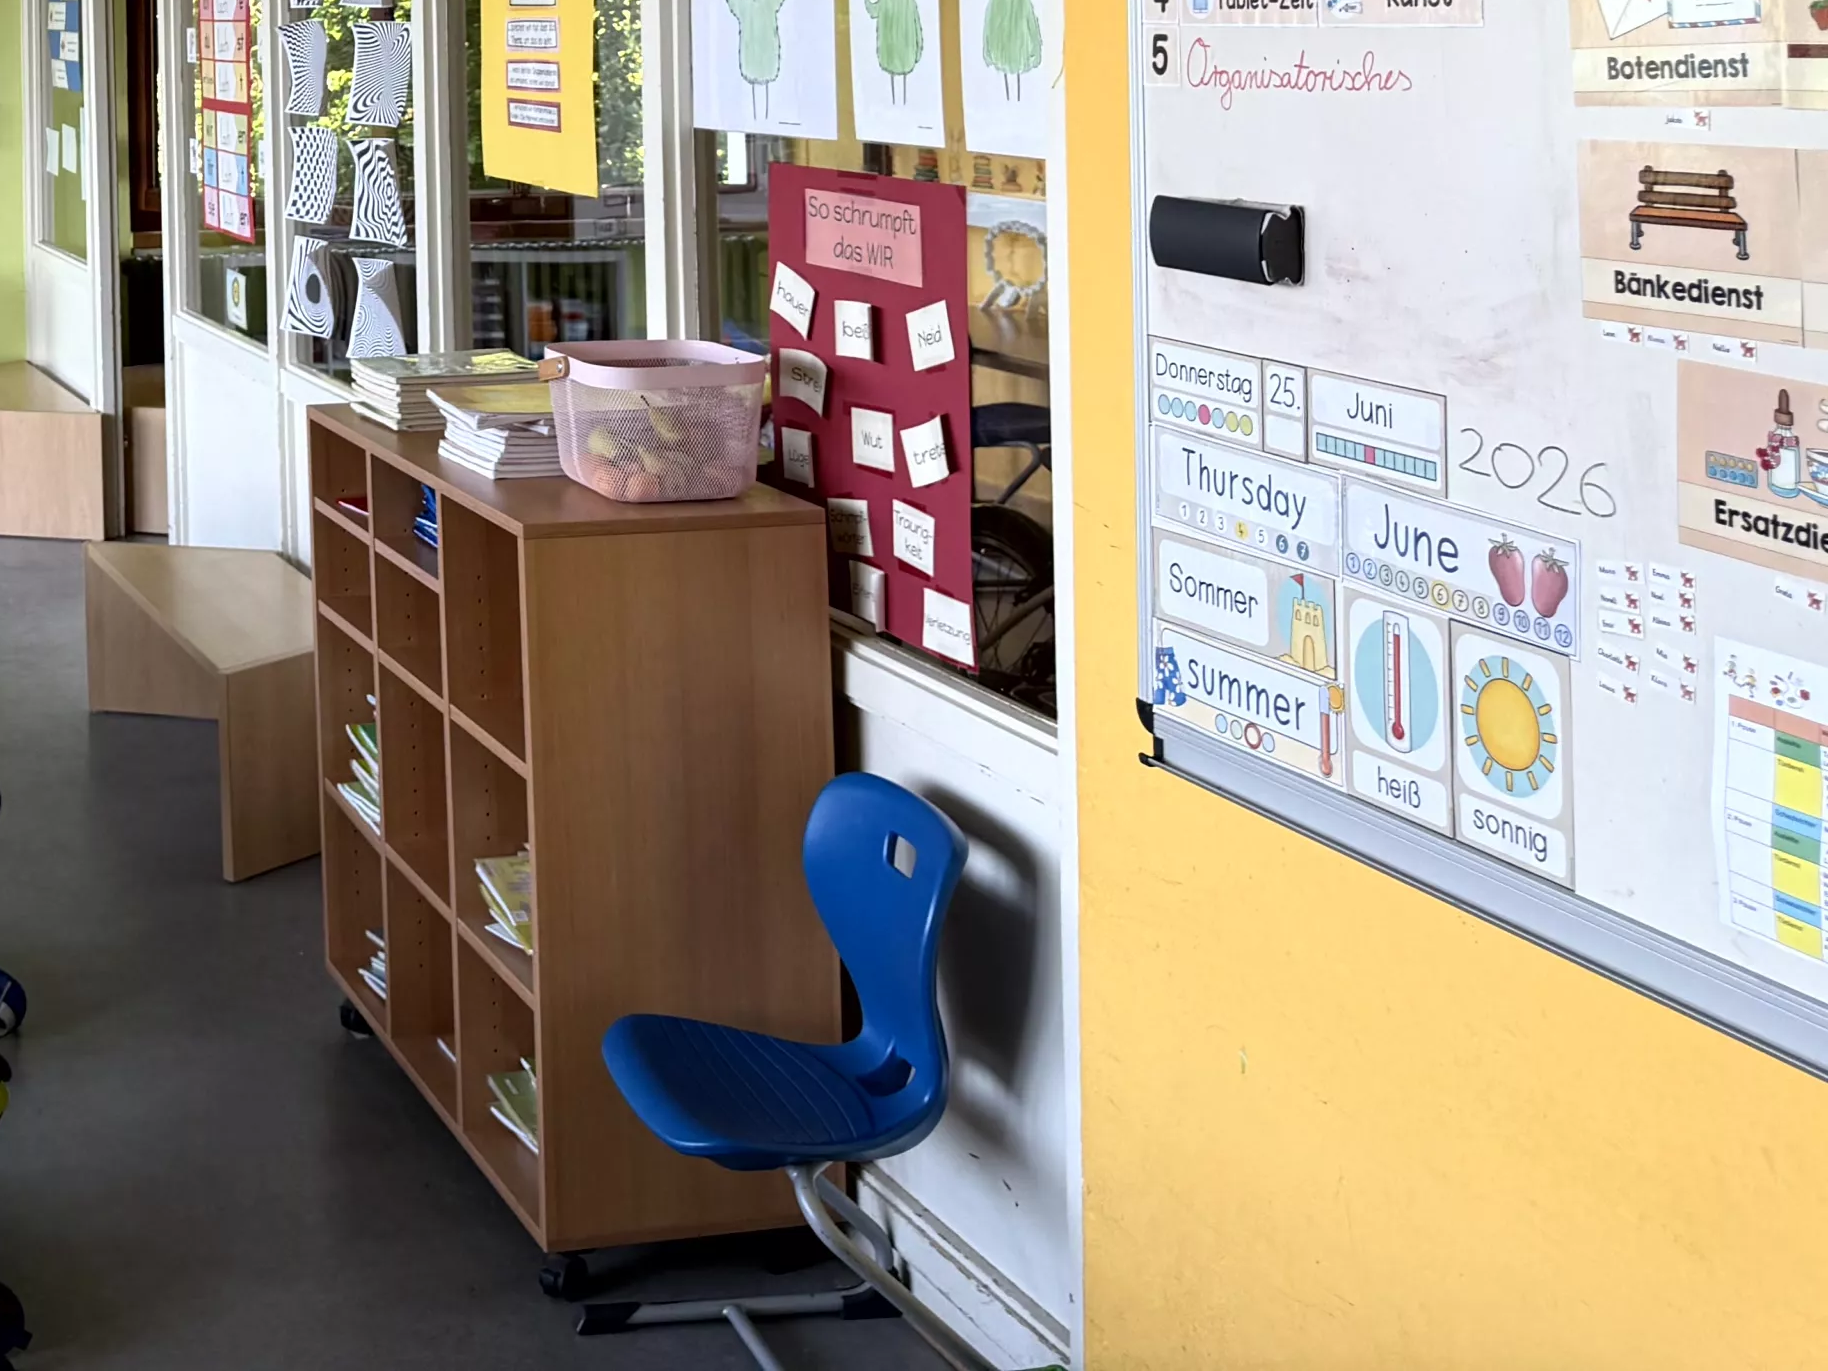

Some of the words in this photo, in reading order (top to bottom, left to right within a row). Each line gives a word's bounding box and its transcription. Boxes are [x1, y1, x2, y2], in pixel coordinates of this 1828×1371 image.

[1151, 34, 1168, 75] 5
[1187, 38, 1413, 110] Organisatorisches
[1607, 53, 1749, 80] Botendienst
[808, 196, 829, 219] So
[834, 201, 916, 238] schrumpft
[834, 237, 862, 262] das
[867, 245, 893, 269] WIR
[1614, 270, 1764, 310] Bänkedienst
[918, 327, 942, 348] Neid
[1156, 353, 1252, 404] Donnerstag
[1270, 373, 1301, 410] 25.
[1347, 392, 1393, 430] Juni
[861, 432, 883, 449] Wut
[1182, 447, 1306, 530] Thursday
[1459, 428, 1617, 518] 2026
[1374, 504, 1460, 575] June
[1170, 563, 1259, 619] Sommer
[1188, 659, 1306, 730] summer
[1377, 766, 1421, 809] heiß
[1473, 808, 1547, 863] sonnig
